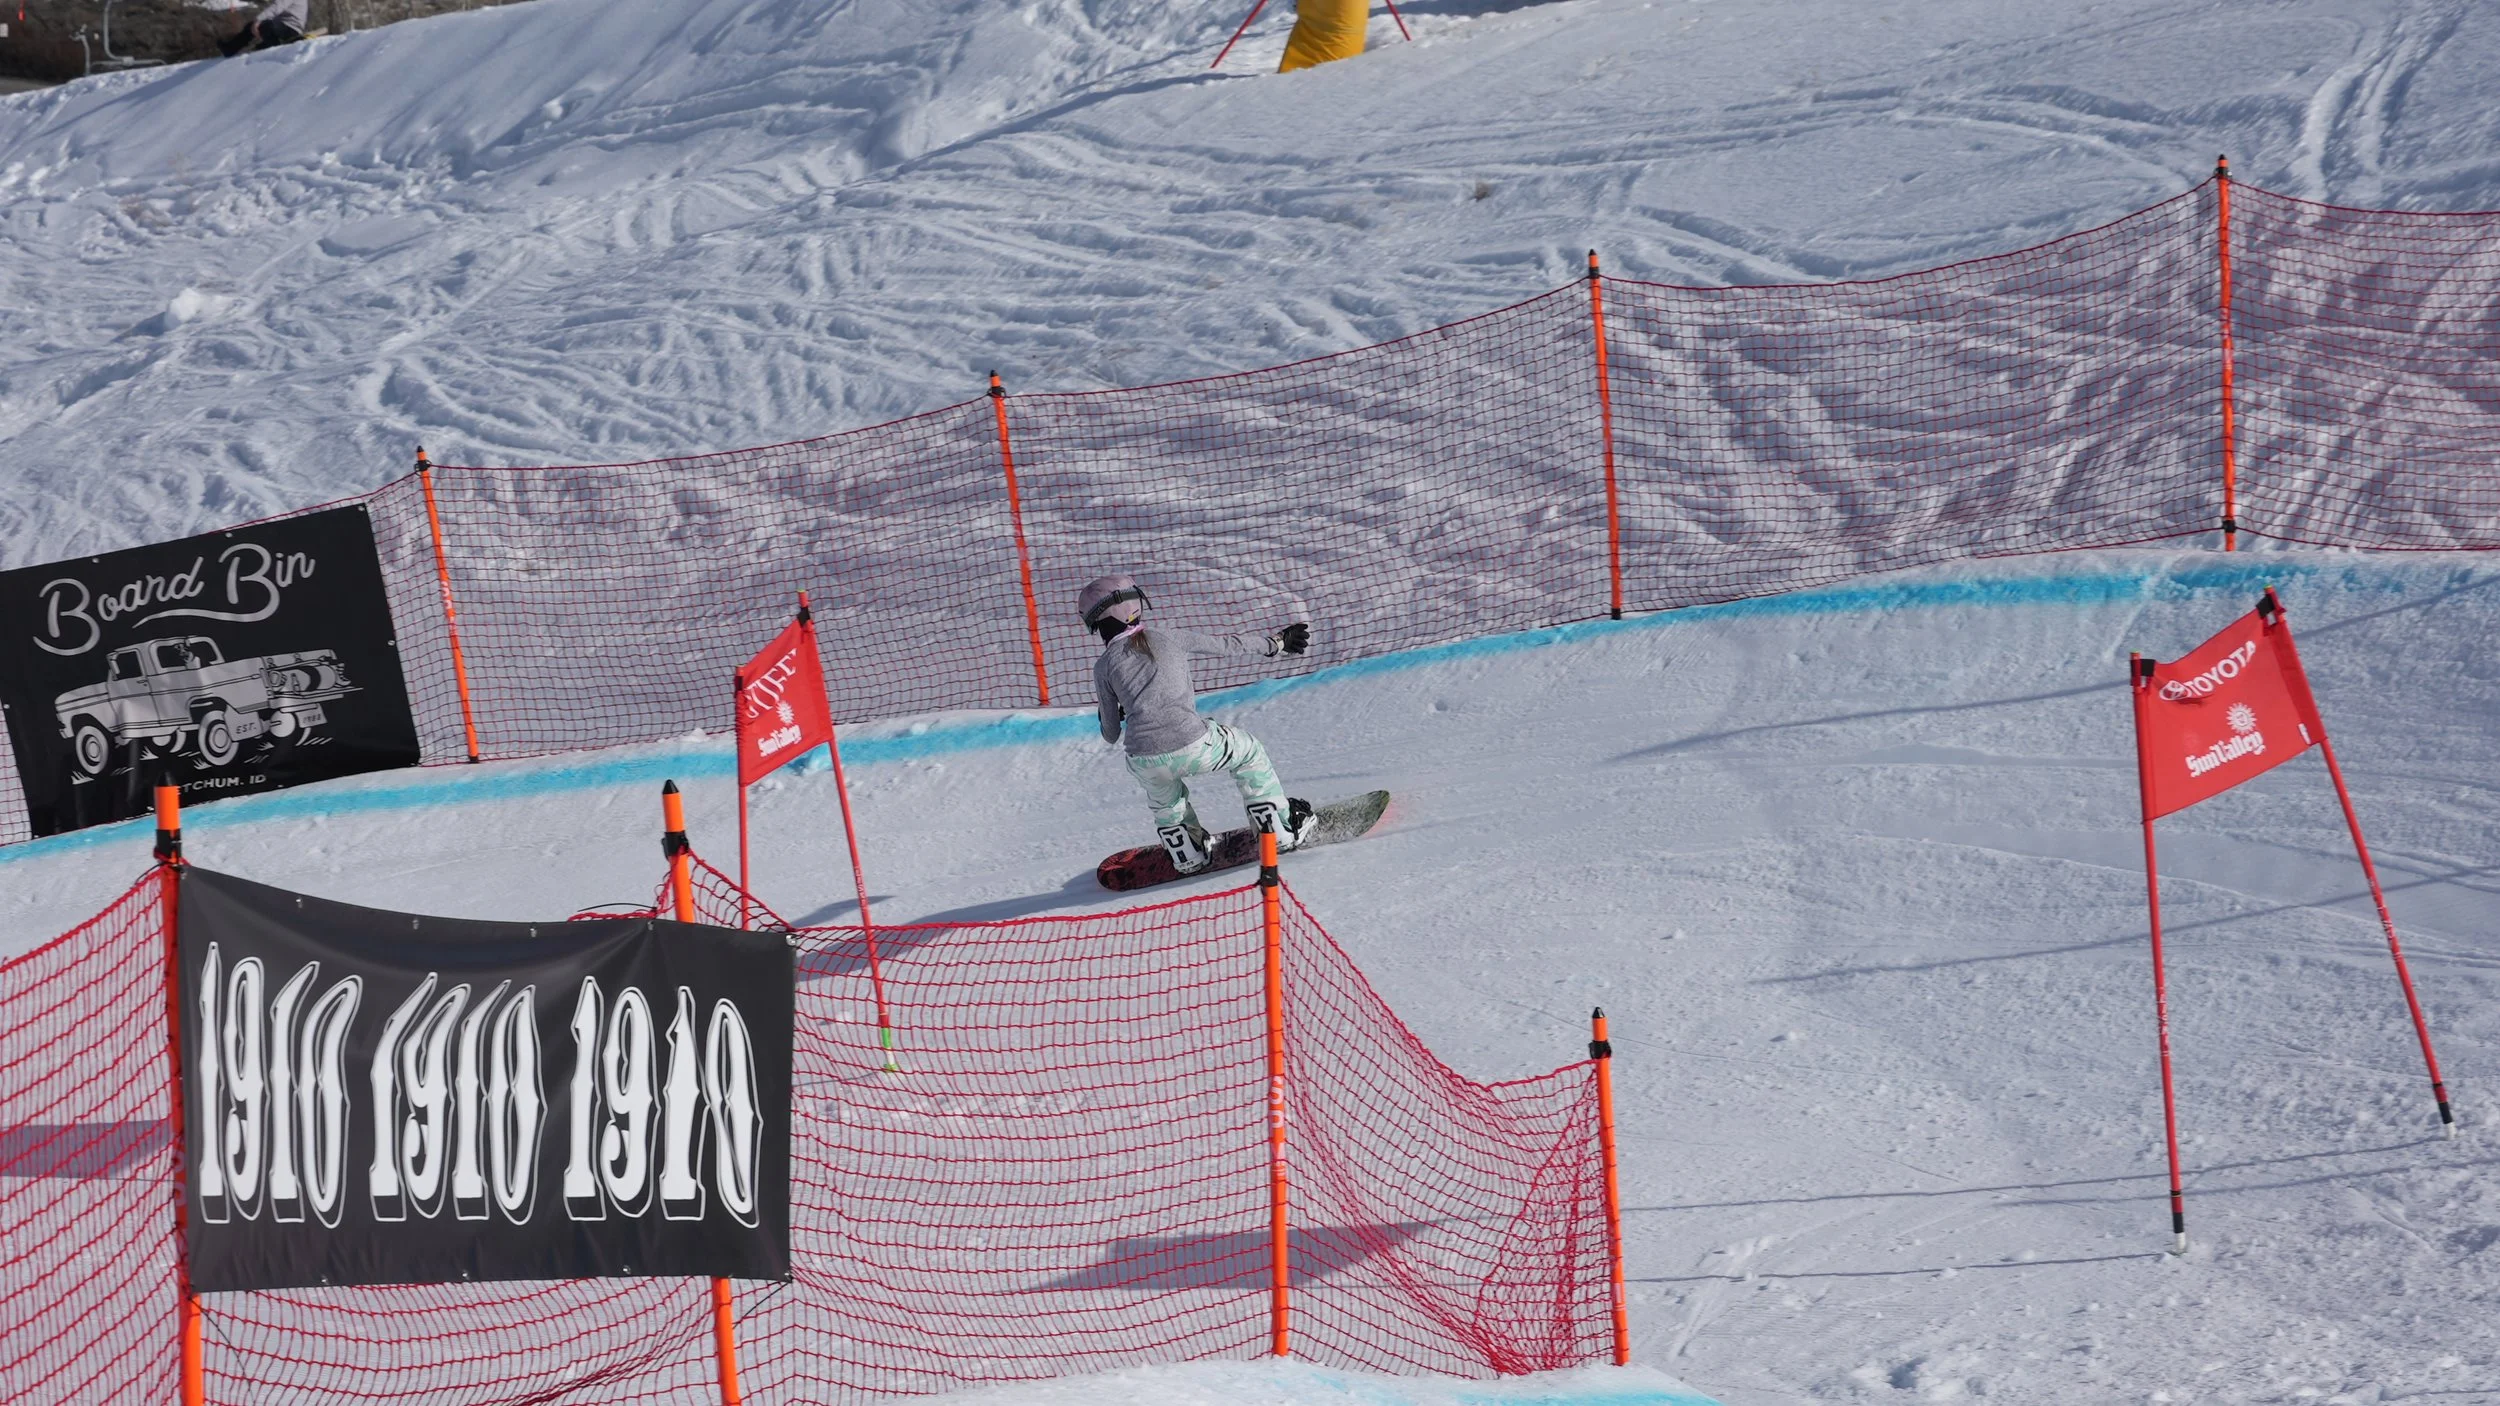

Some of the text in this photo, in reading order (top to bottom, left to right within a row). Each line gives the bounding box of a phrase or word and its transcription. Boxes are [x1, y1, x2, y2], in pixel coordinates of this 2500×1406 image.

[33, 543, 315, 656] Board Bin
[2184, 640, 2256, 696] TOYOTA
[177, 774, 267, 793] TCHUM. ID
[200, 941, 763, 1228] 1910 1910 1910
